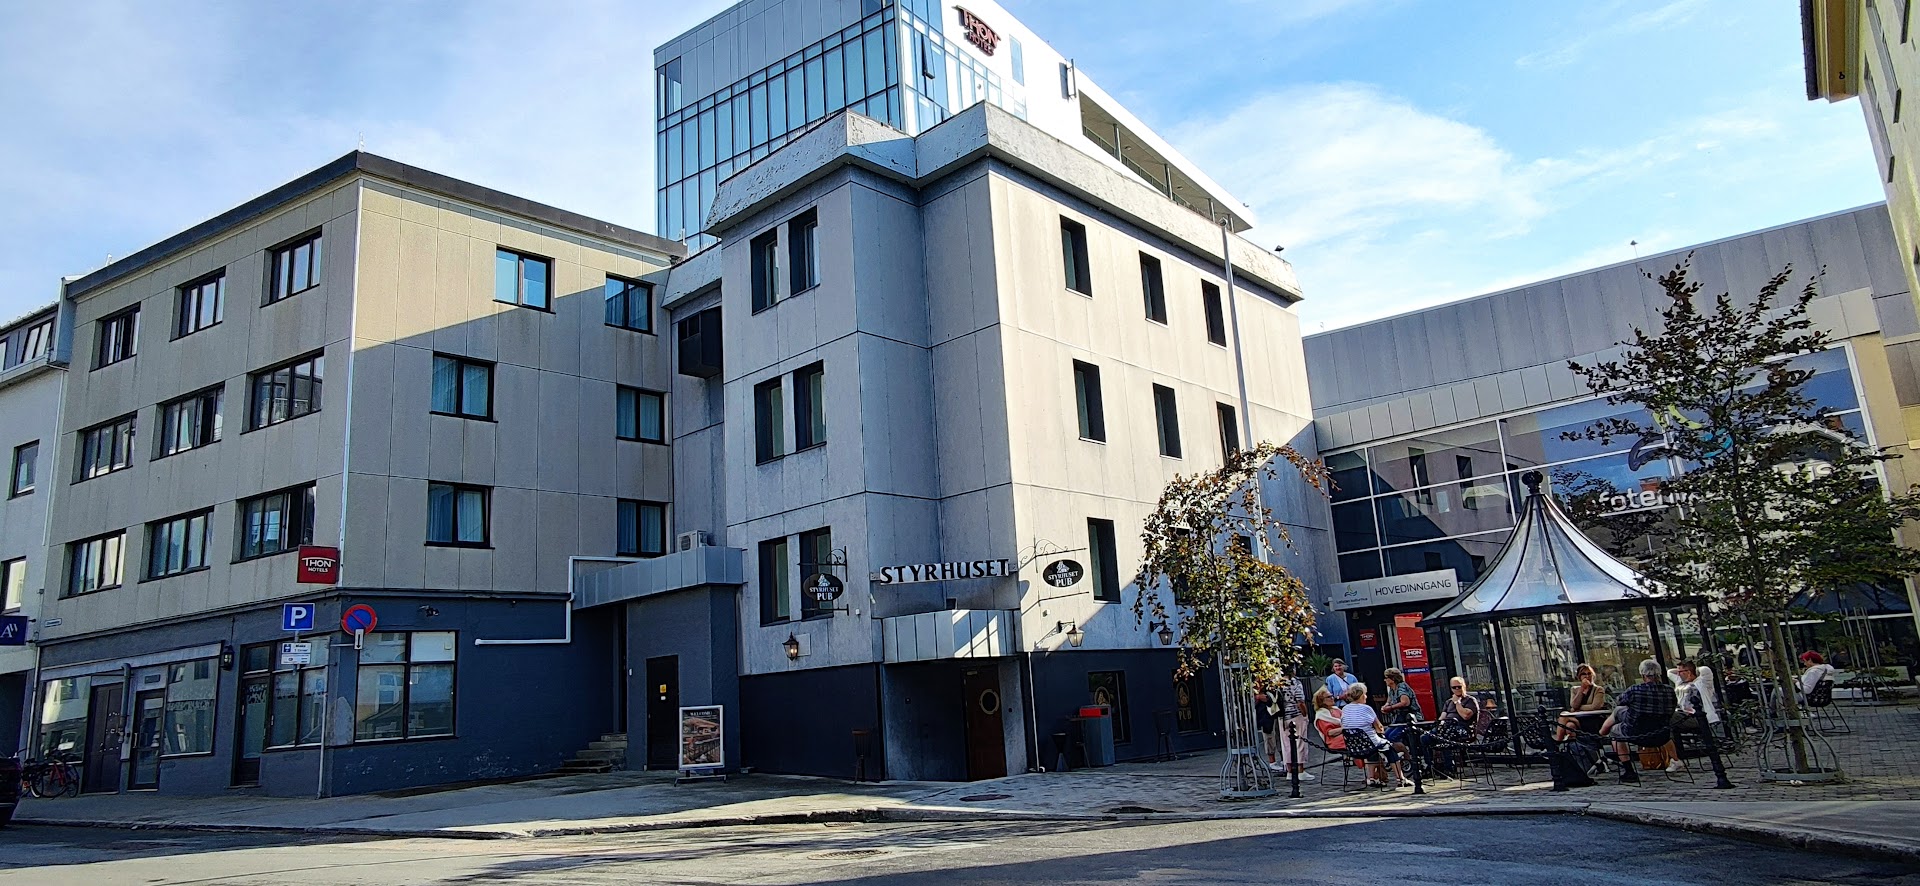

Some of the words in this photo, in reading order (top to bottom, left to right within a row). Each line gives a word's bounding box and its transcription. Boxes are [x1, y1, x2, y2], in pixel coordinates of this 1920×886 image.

[951, 5, 1001, 48] THON
[301, 557, 336, 568] THON
[880, 559, 1009, 584] STYRHUSET
[1048, 571, 1078, 580] STYRHUSET
[1056, 578, 1073, 587] PUB
[1375, 579, 1452, 596] HOVEDINNGANG
[817, 592, 833, 601] PUB
[291, 607, 307, 626] P
